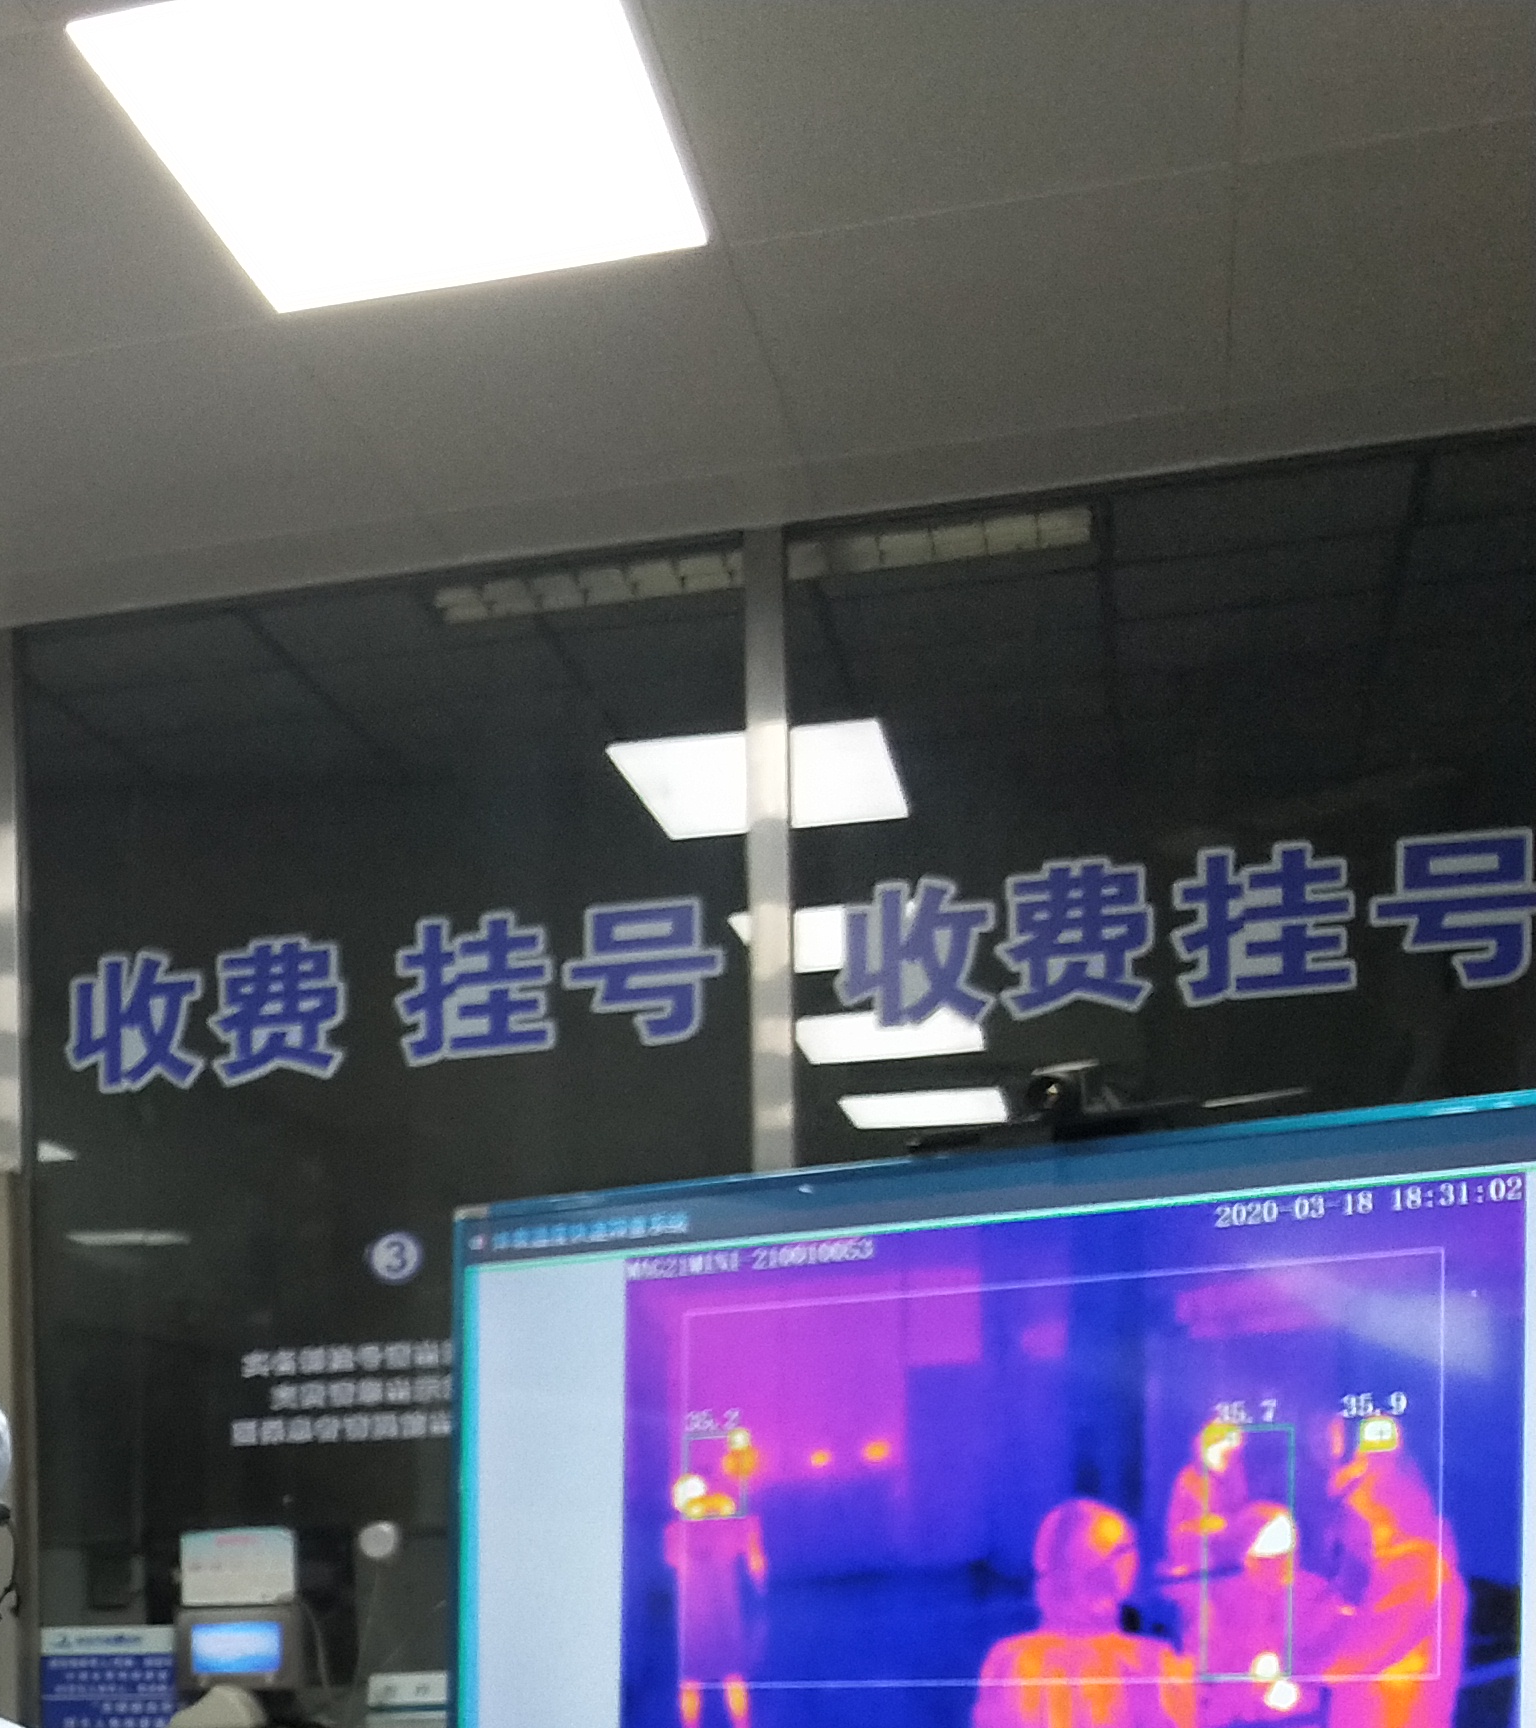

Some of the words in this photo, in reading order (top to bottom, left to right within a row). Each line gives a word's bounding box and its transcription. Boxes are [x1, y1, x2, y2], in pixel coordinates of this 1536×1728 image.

[836, 828, 1536, 1028] 收费挂号
[67, 934, 346, 1093] 收费
[395, 896, 726, 1067] 挂号
[1214, 1191, 1373, 1228] 2020-03-18
[1392, 1177, 1523, 1212] 18:31:02
[1341, 1391, 1408, 1419] 35.9
